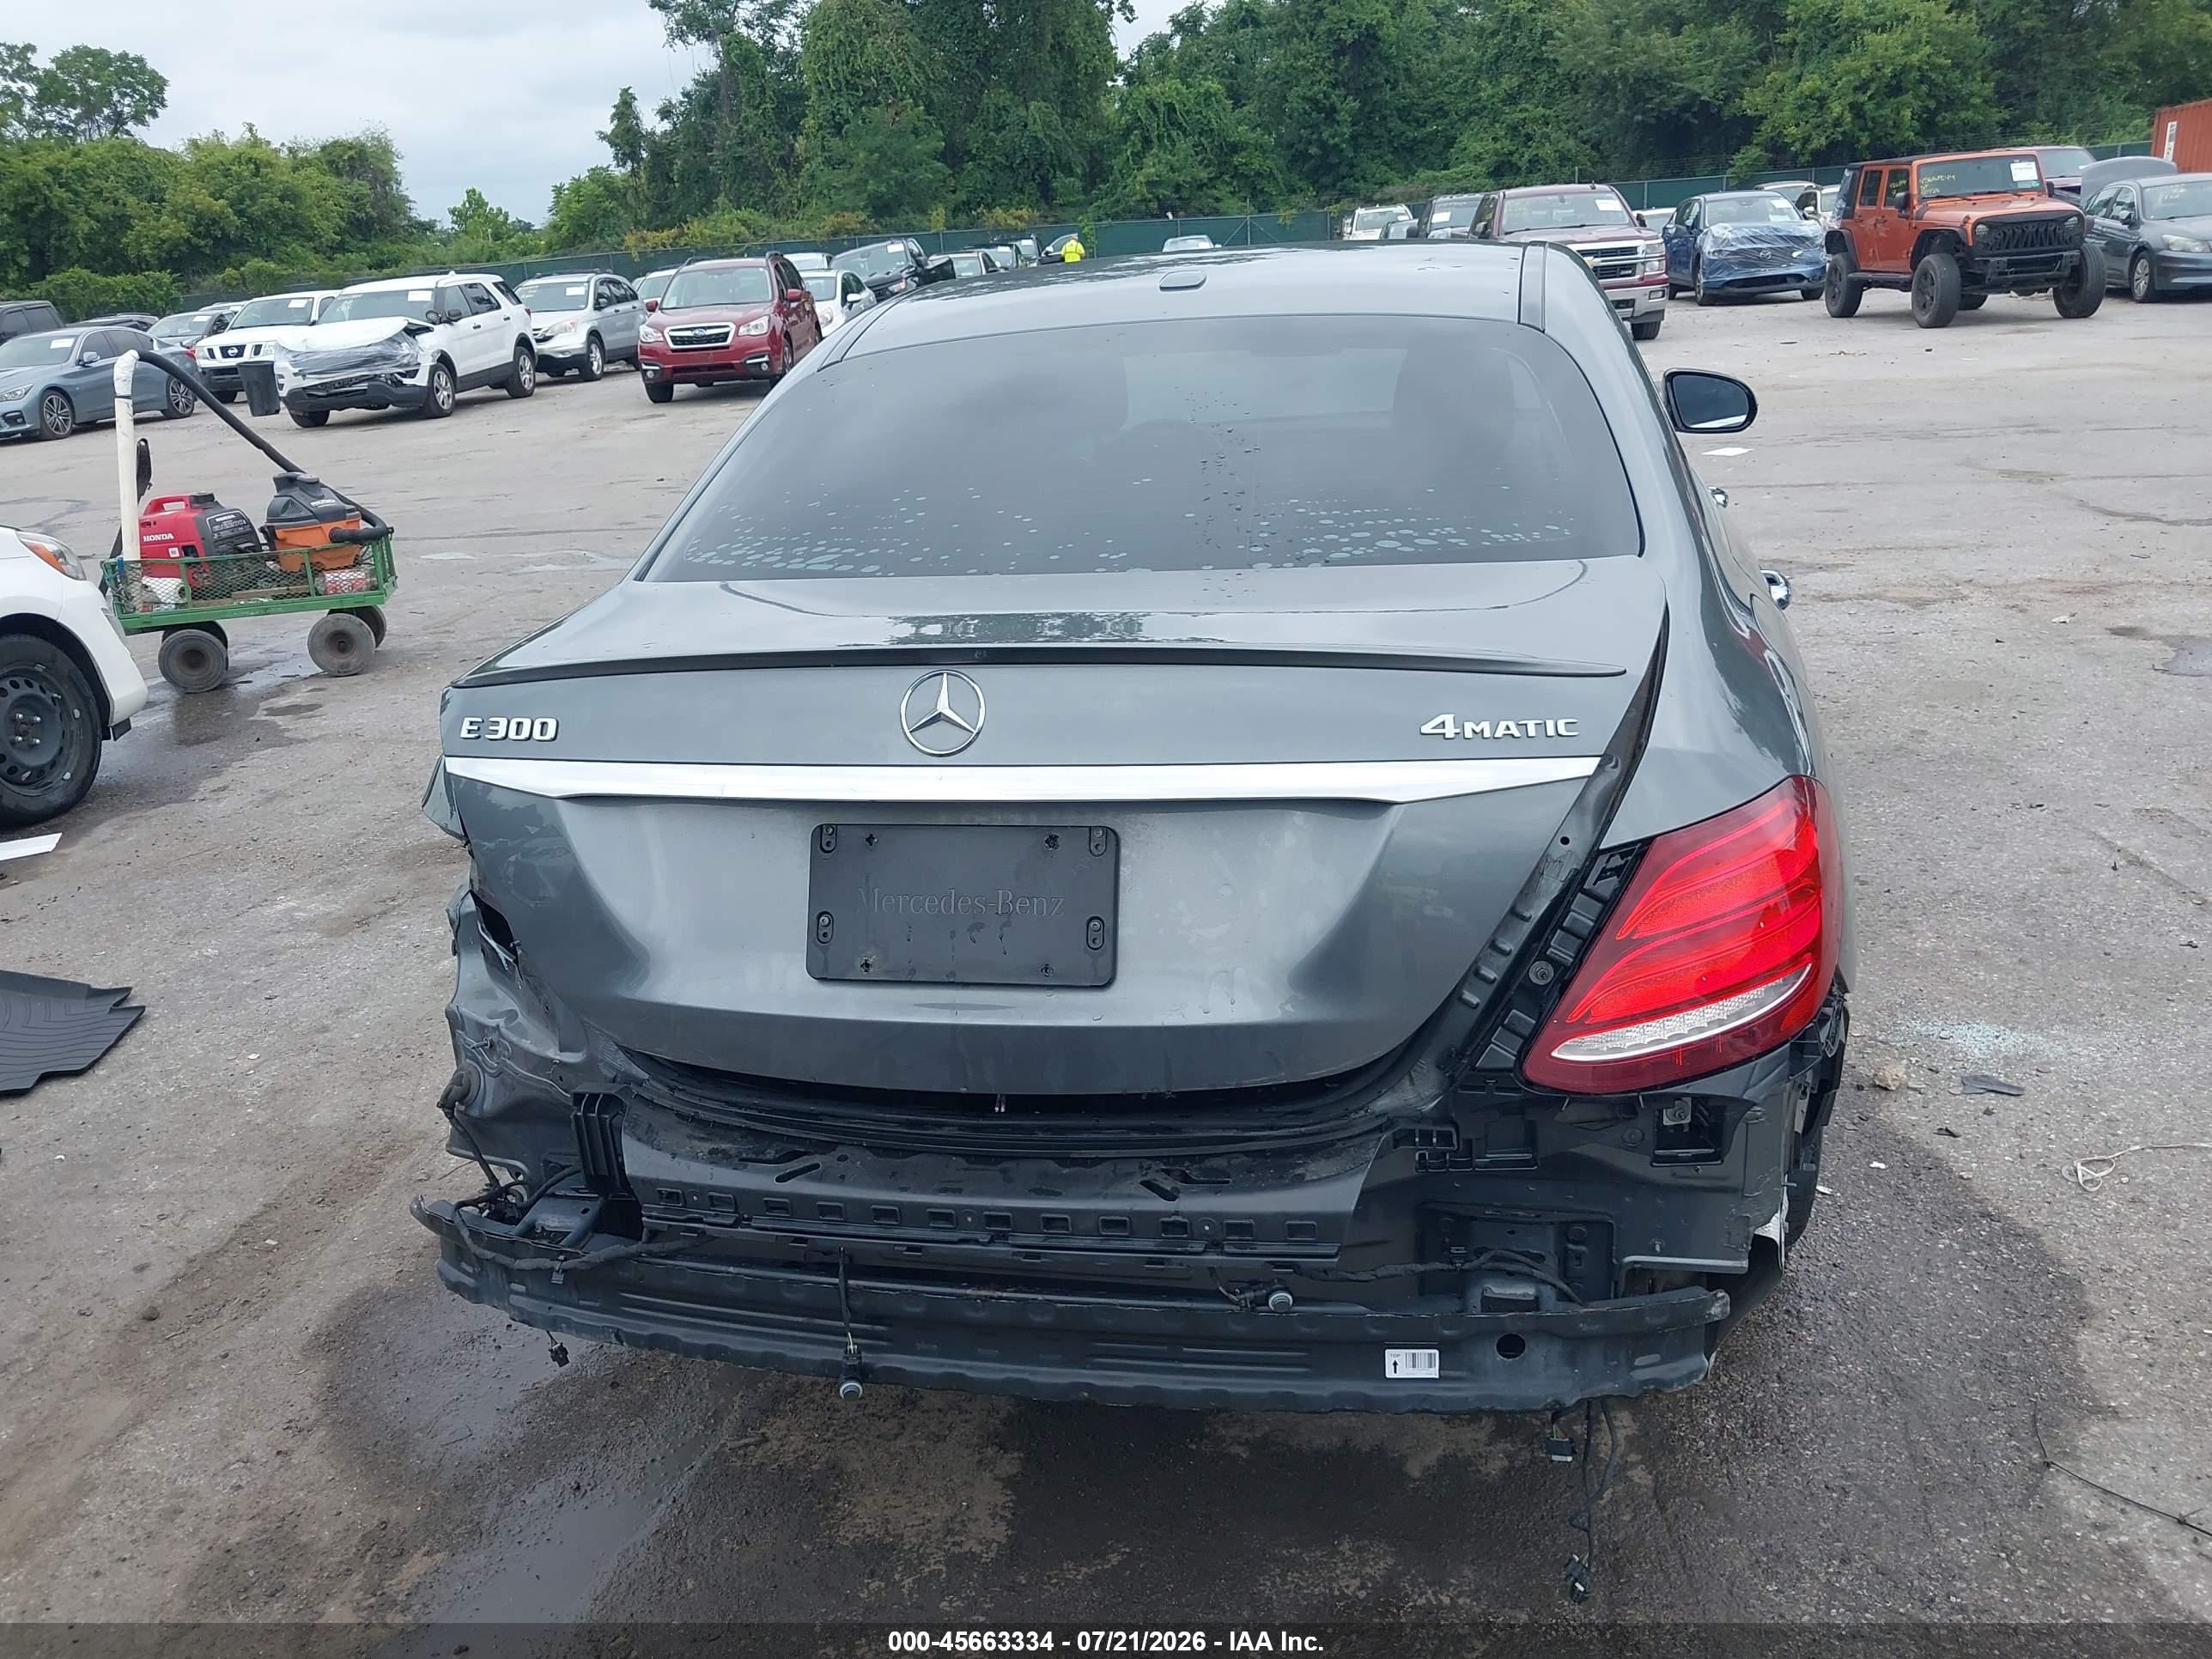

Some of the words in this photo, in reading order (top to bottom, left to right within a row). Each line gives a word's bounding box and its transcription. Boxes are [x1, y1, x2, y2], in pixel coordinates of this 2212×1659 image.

[143, 532, 174, 543] HONDA
[459, 716, 484, 739] E
[484, 716, 559, 742] 300
[1419, 713, 1580, 739] 4MATIC
[858, 888, 1066, 917] Mercedes-Benz
